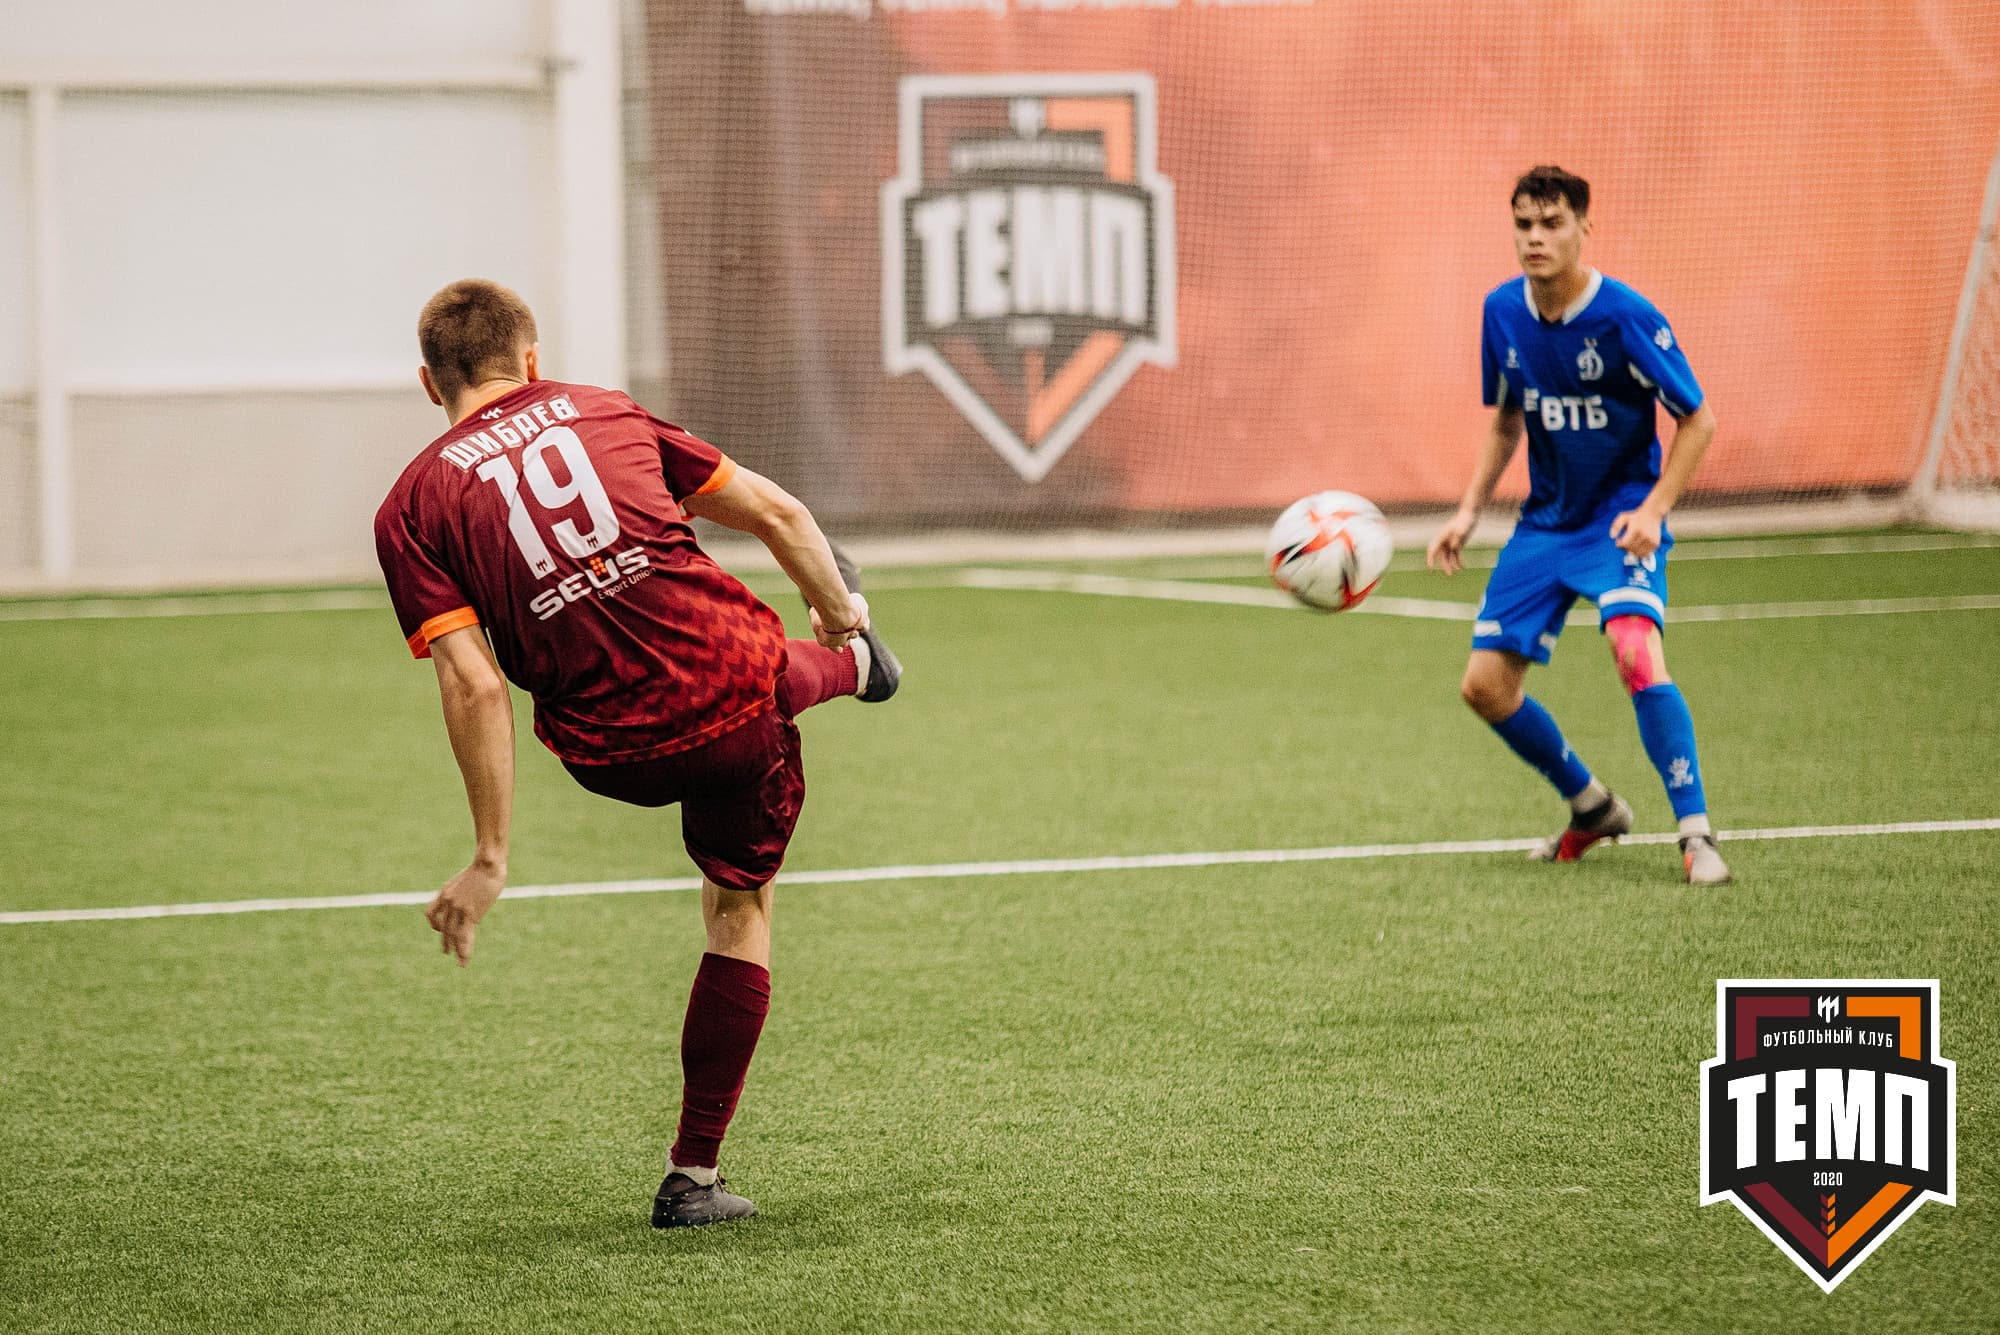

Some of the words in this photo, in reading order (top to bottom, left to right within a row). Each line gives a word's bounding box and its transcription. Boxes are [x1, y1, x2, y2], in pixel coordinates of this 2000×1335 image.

[912, 186, 1147, 328] ТЕМП
[440, 397, 577, 470] ШИБАЕВ
[1541, 395, 1608, 431] ВТБ
[475, 425, 621, 581] 19
[597, 580, 629, 600] Export
[627, 567, 657, 585] Union
